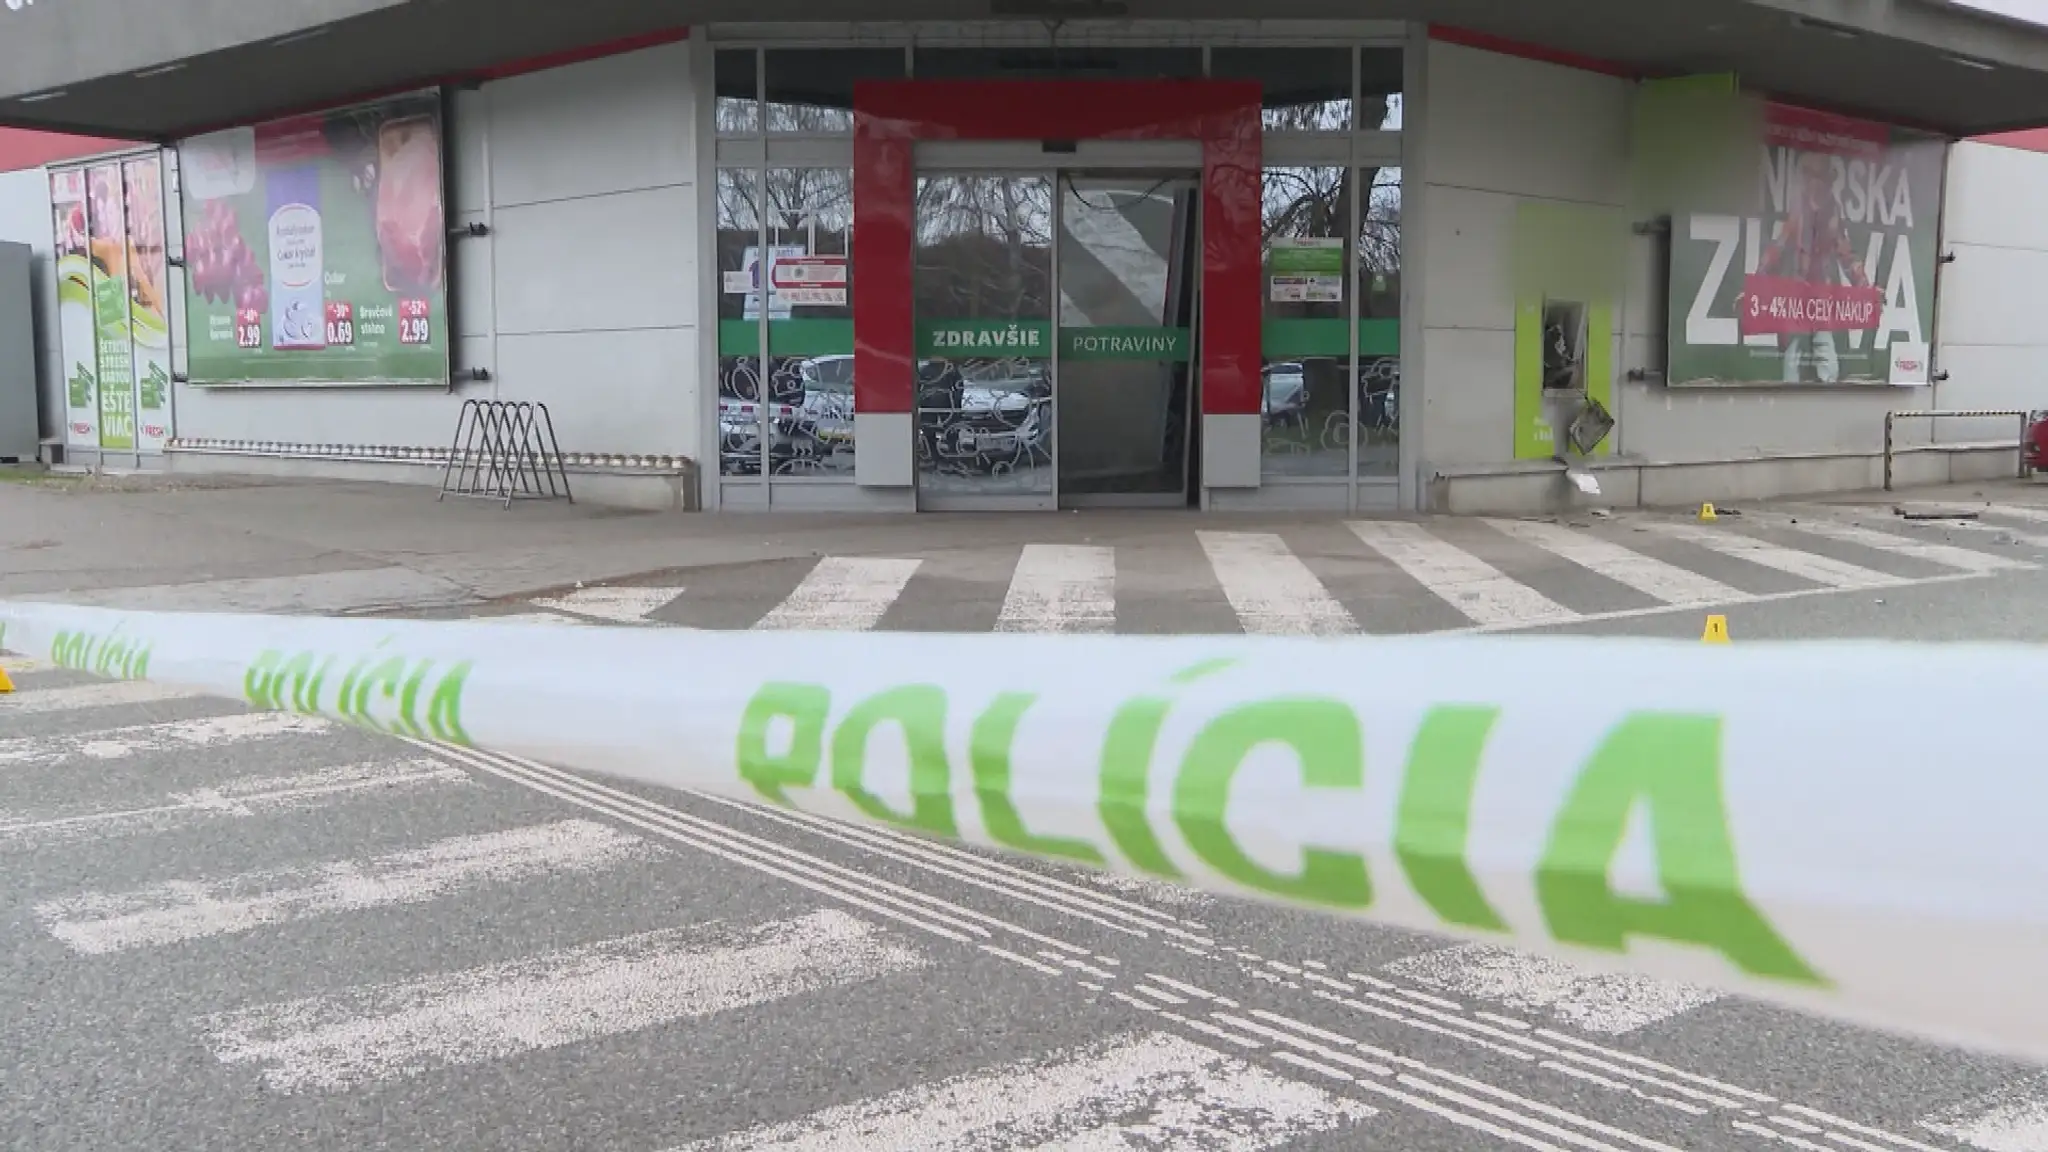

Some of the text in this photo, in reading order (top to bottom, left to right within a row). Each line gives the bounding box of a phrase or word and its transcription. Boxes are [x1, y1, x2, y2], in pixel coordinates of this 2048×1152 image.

[1788, 298, 1804, 319] NA
[1806, 295, 1834, 323] CELÝ
[1835, 296, 1874, 323] NÁKUP
[239, 325, 260, 346] 2.99
[327, 320, 352, 343] 0.69
[400, 318, 429, 342] 2.99
[932, 325, 1040, 347] ZDRAVŠIE
[1073, 336, 1177, 352] POTRAVINY
[103, 385, 132, 412] EŠTE
[104, 415, 133, 437] VIAC
[244, 632, 475, 746] POLÍCIA
[736, 657, 1839, 988] POLÍCIA
